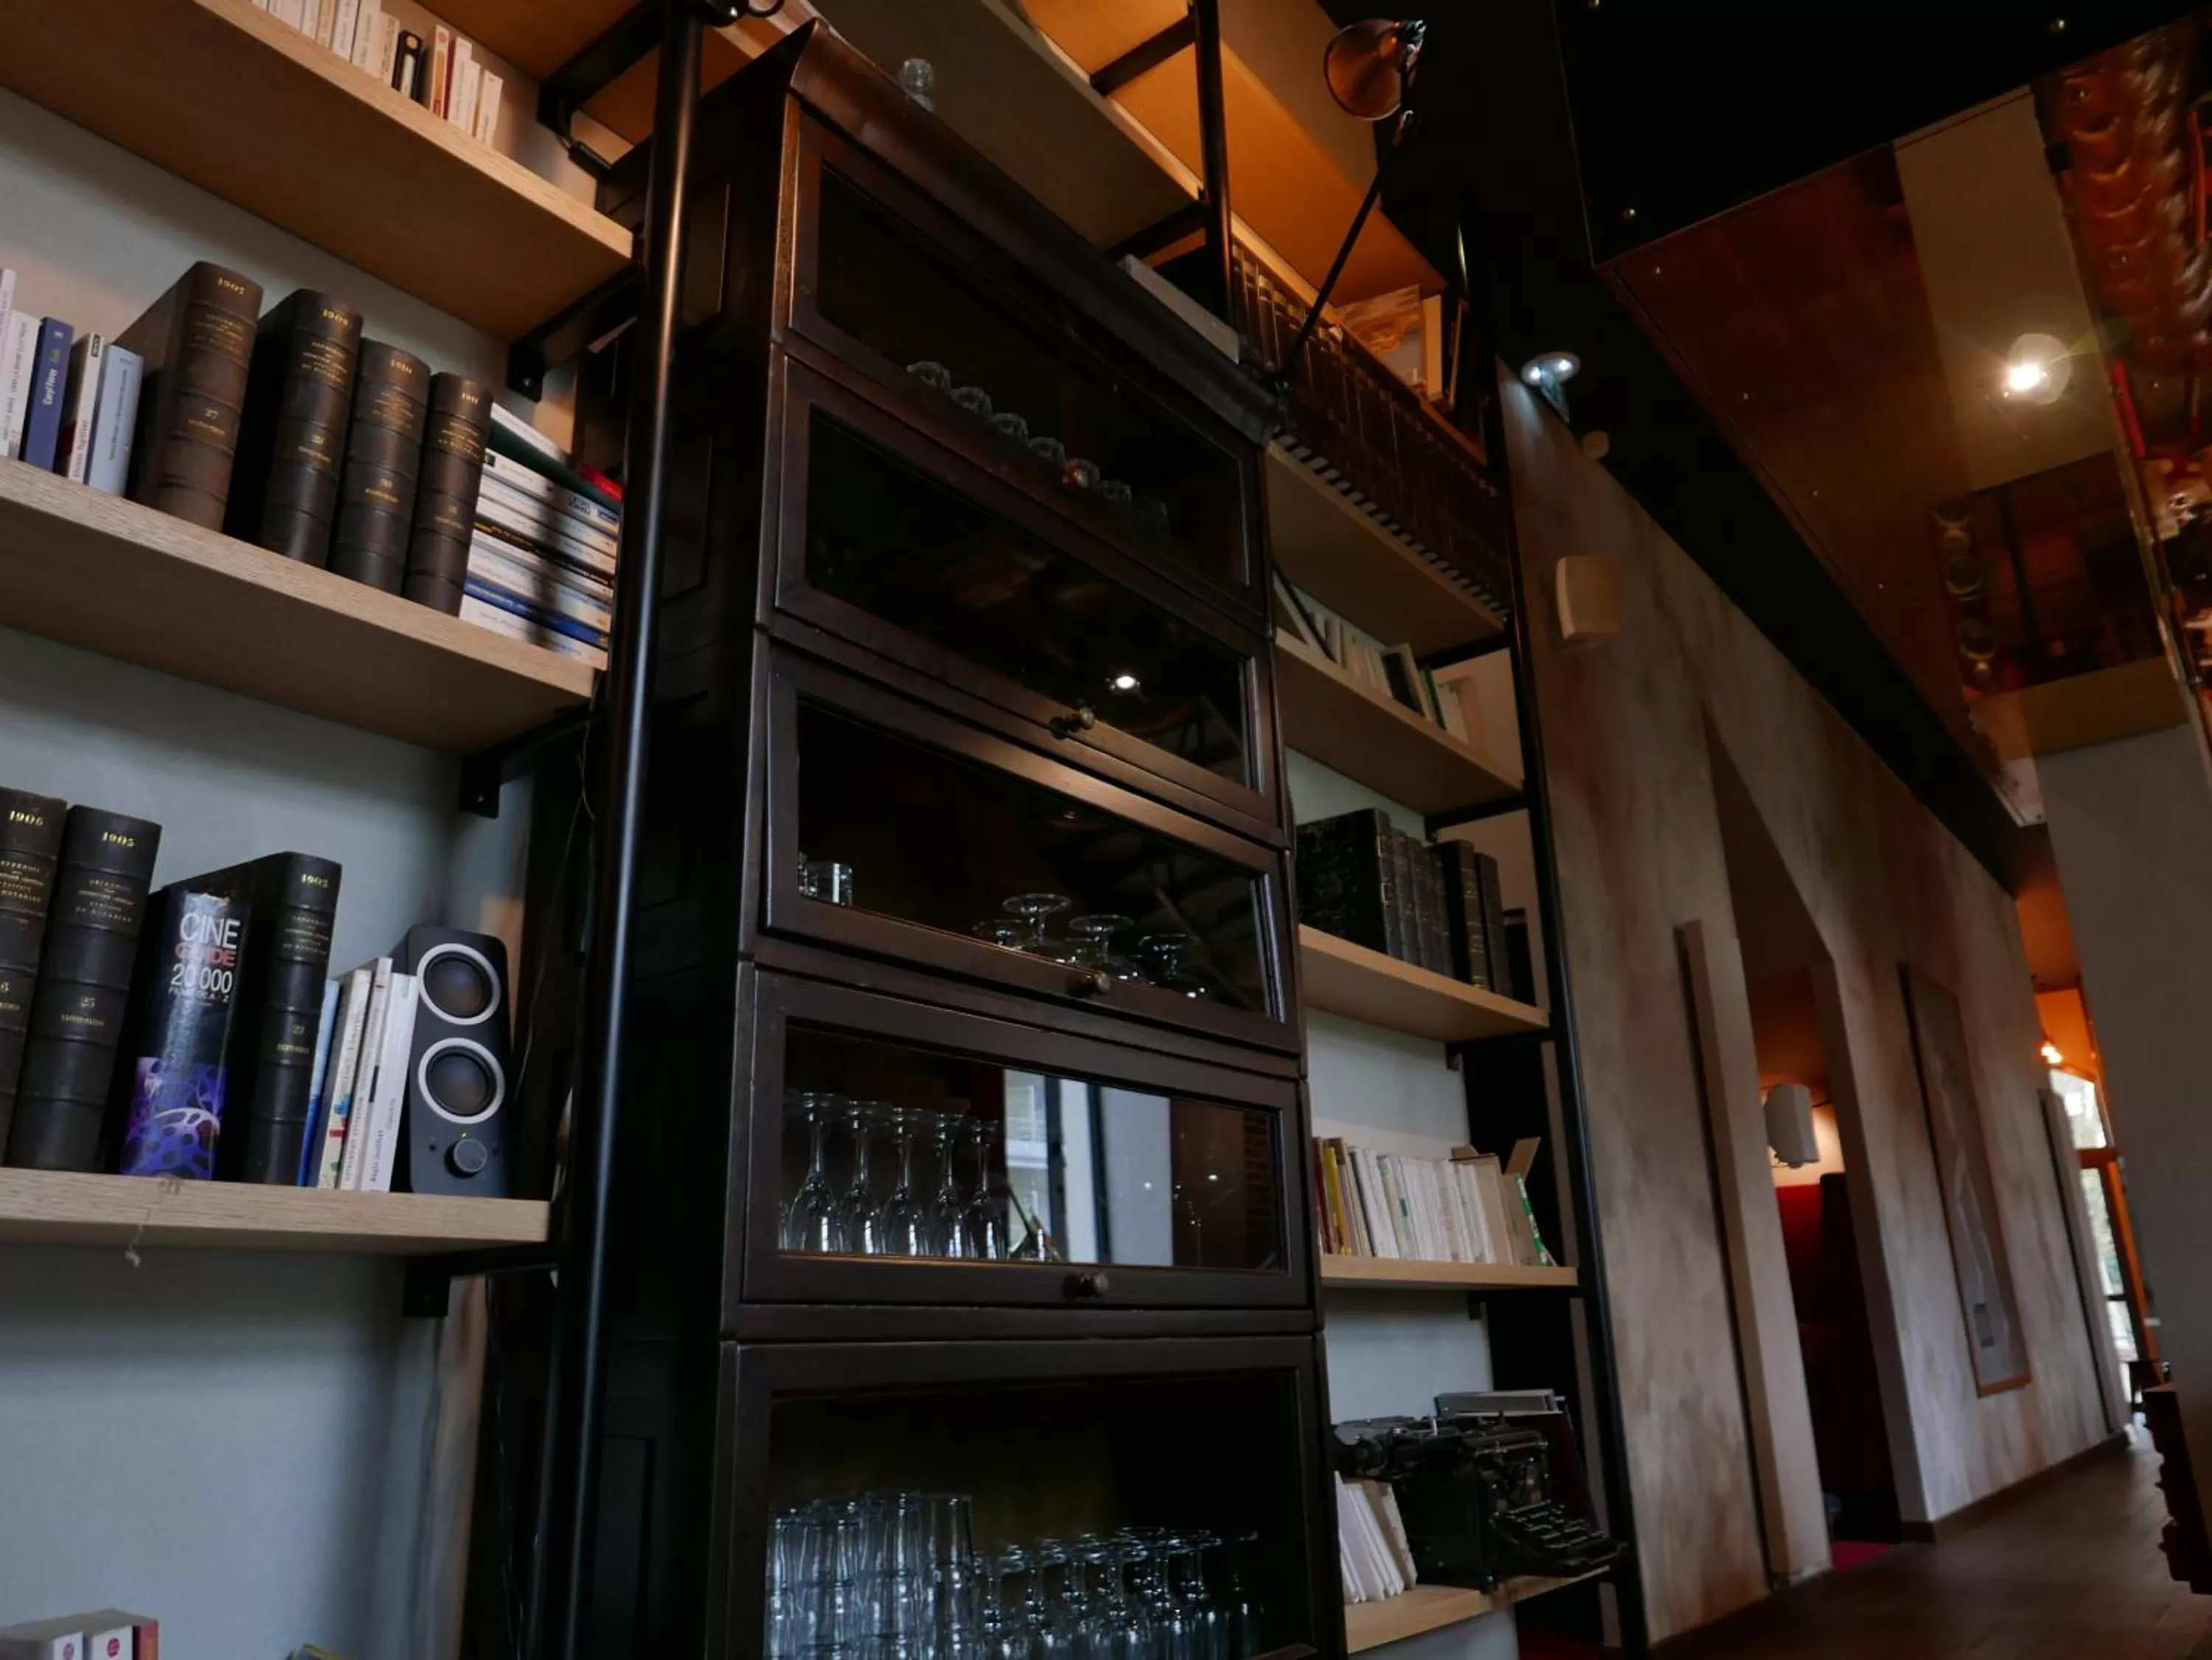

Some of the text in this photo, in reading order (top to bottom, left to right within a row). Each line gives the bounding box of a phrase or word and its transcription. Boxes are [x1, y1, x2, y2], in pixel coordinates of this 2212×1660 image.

[102, 831, 136, 848] 1905
[180, 913, 242, 949] CINE
[175, 941, 237, 968] GDE
